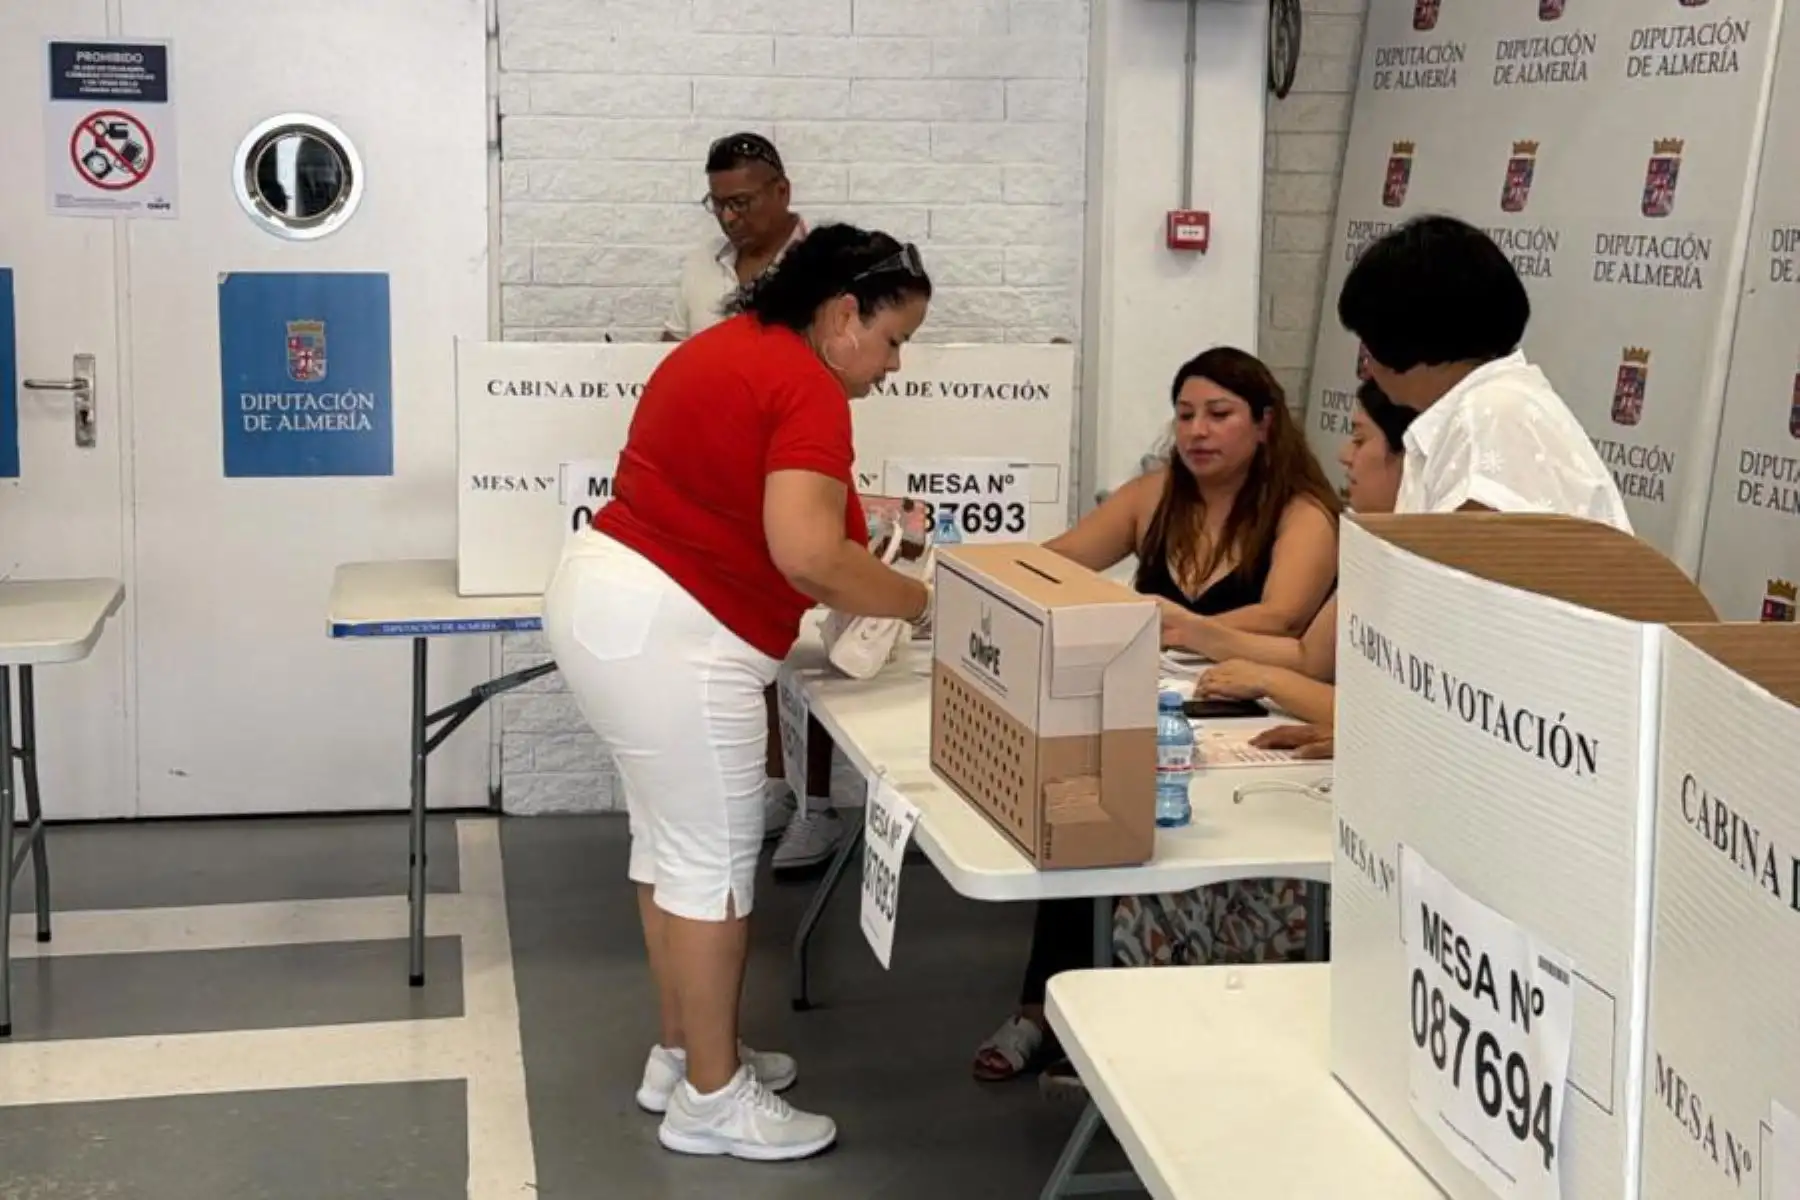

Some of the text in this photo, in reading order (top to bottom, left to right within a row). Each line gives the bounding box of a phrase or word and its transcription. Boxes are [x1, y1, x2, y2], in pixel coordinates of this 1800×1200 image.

[1496, 29, 1597, 60] DIPUTACIÓN
[1629, 17, 1750, 51] DIPUTACIÓN
[76, 51, 144, 63] PROHIBIDO
[1375, 40, 1466, 67] DIPUTACIÓN
[1627, 46, 1739, 78] DE ALMERÍA
[1373, 66, 1457, 90] DE ALMERÍA
[1493, 56, 1588, 86] DE ALMERÍA
[1595, 232, 1712, 261] DIPUTACIÓN
[1593, 261, 1703, 289] DE ALMERÍA
[1771, 259, 1793, 282] DE
[239, 387, 375, 411] DIPUTACIÓN
[487, 379, 574, 398] CABINA
[580, 382, 609, 398] DE
[905, 381, 933, 397] DE
[939, 378, 1051, 401] VOTACIÓN
[243, 410, 373, 432] DE ALMERÍA
[471, 475, 528, 491] MESA
[907, 473, 1015, 494] MESA Nº
[1737, 480, 1765, 506] DE
[1350, 614, 1599, 777] CABINA DE VOTACIÓN
[1681, 773, 1781, 898] CABINA
[1339, 816, 1376, 884] MESA
[1421, 901, 1545, 1035] MESA Nº
[1411, 967, 1555, 1171] 087694
[1655, 1050, 1719, 1163] MESA
